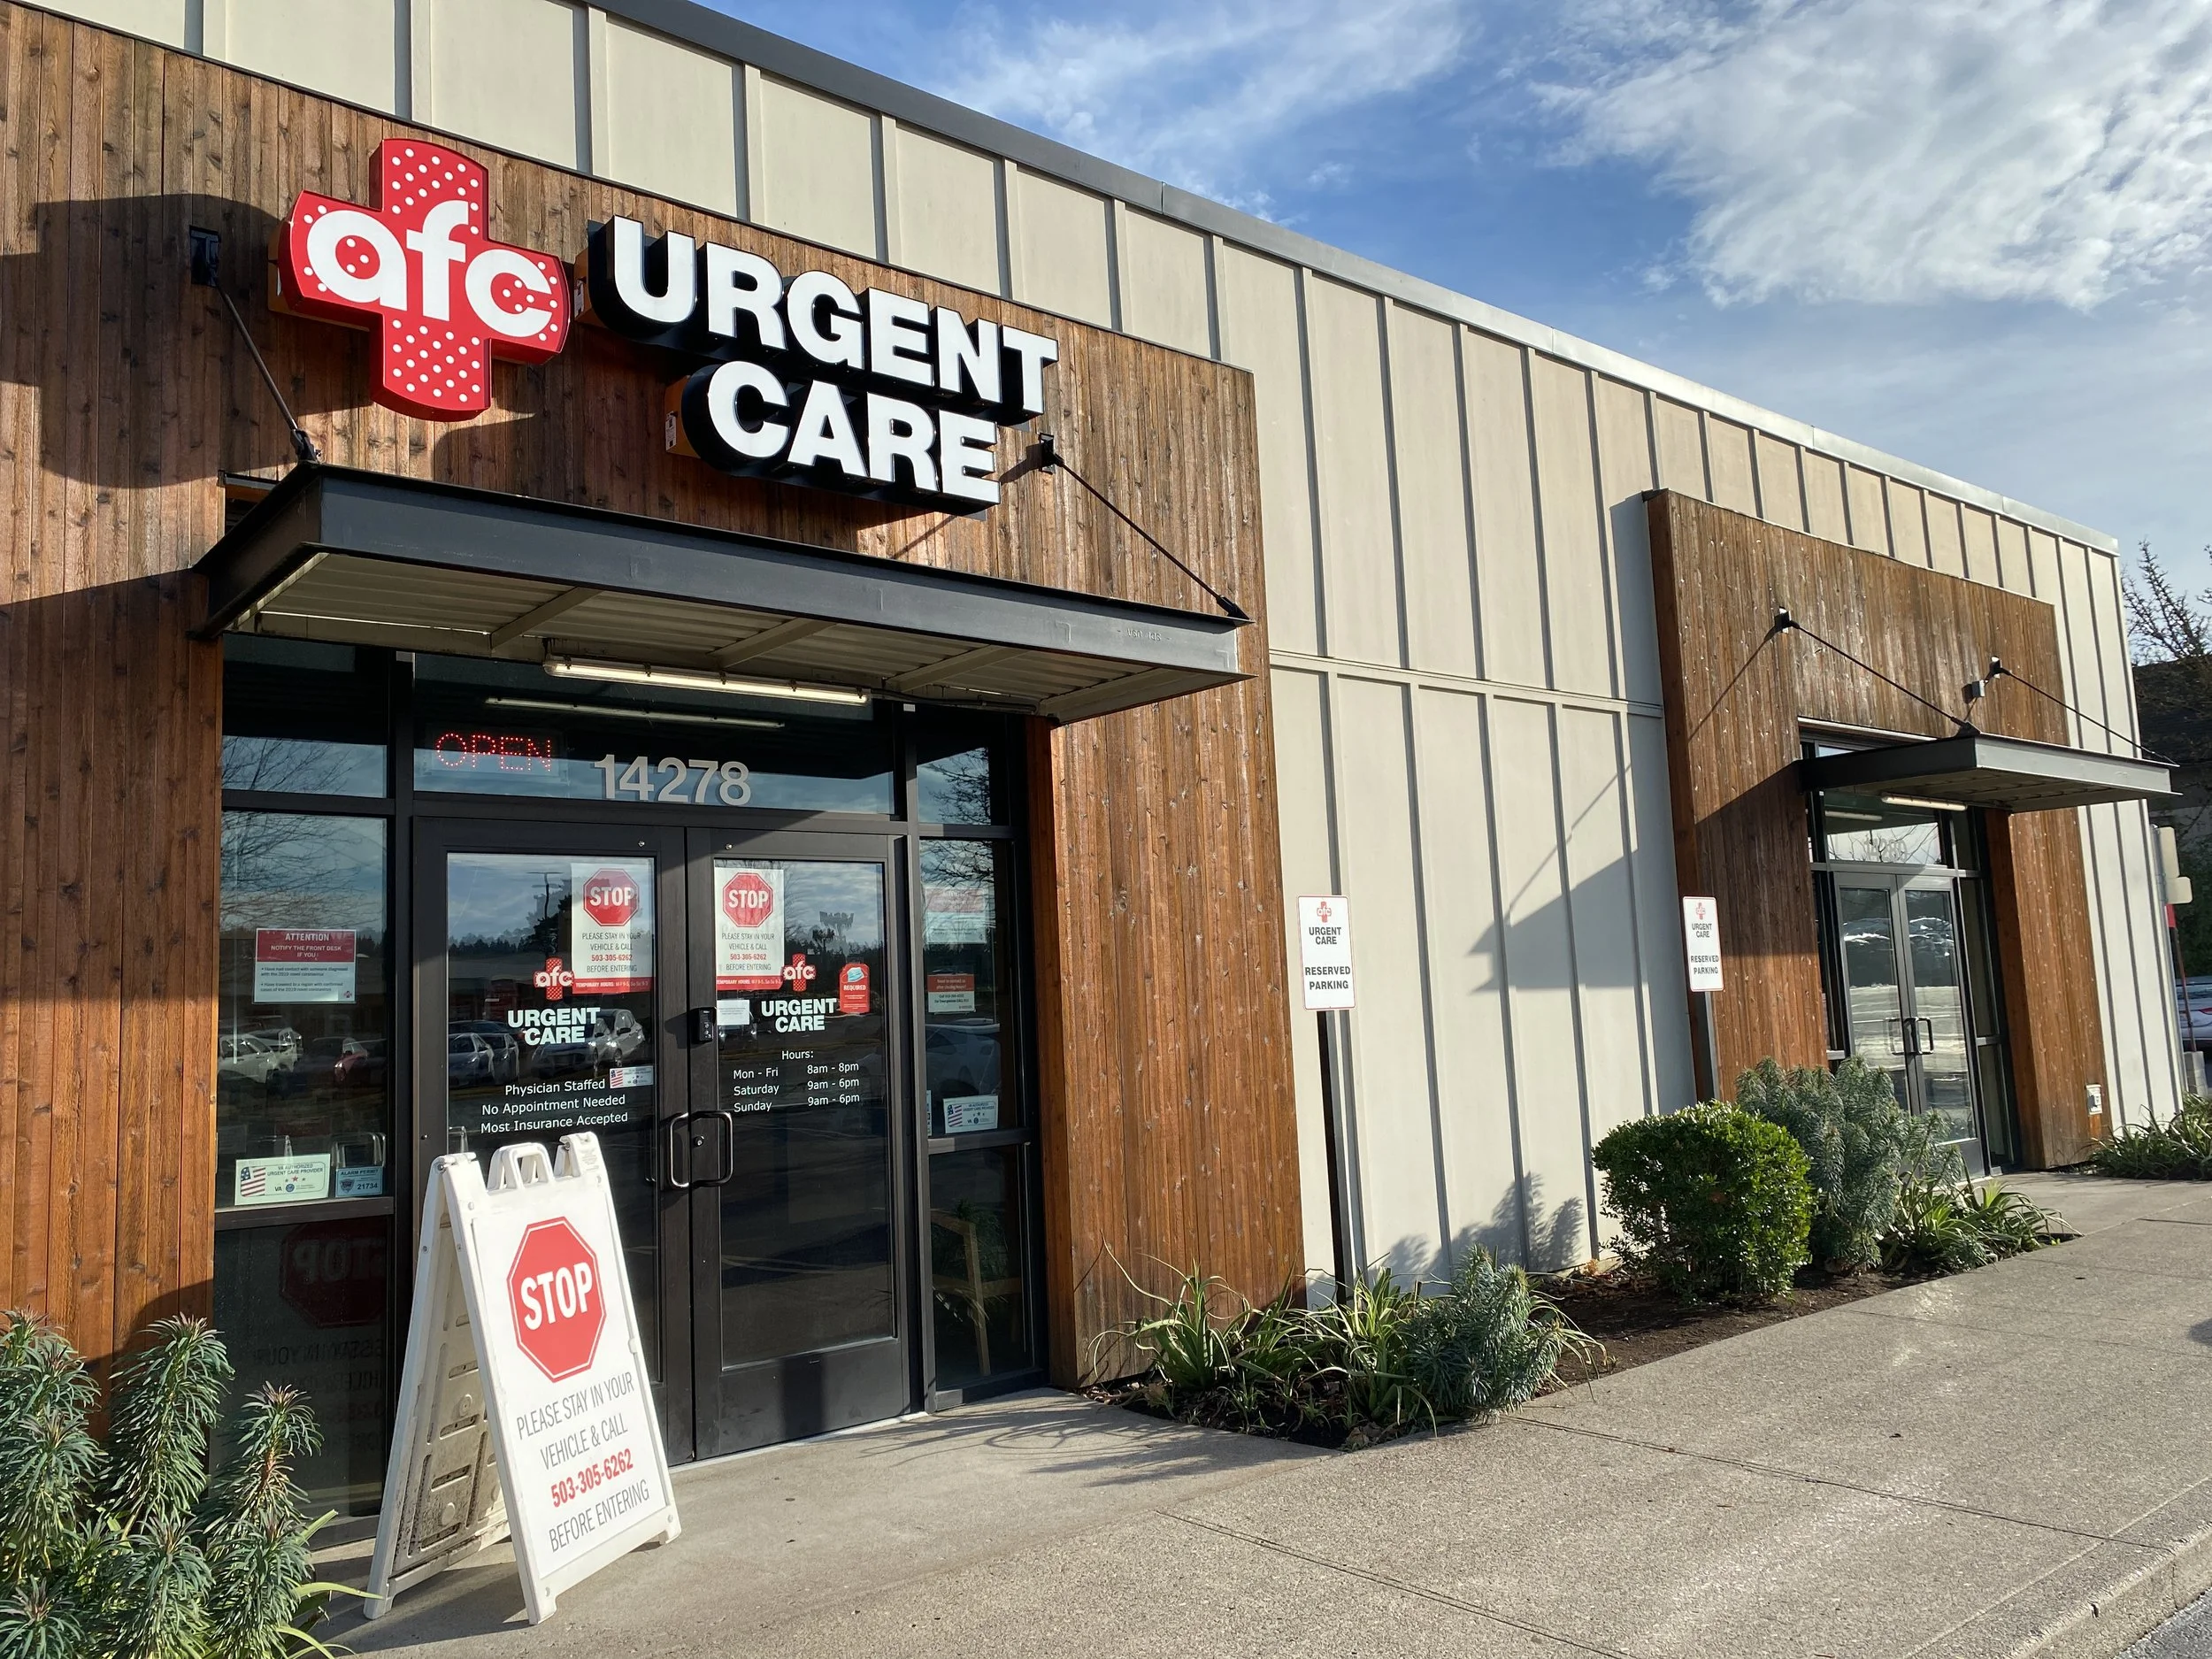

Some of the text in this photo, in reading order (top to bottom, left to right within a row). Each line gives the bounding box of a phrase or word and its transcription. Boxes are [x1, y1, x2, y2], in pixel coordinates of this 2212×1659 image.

[306, 199, 555, 336] afc
[613, 215, 1058, 415] URGENT
[708, 361, 1000, 504] CARE
[436, 733, 551, 772] OPEN
[594, 754, 751, 806] 14278
[590, 887, 634, 906] STOP
[728, 889, 769, 909] STOP
[1317, 905, 1332, 917] afc
[285, 933, 329, 941] ATTENTION
[1316, 936, 1337, 945] CARE
[535, 966, 573, 987] afc
[783, 960, 816, 980] afc
[1305, 966, 1350, 975] RESERVED
[1310, 980, 1348, 990] PARKING
[761, 998, 837, 1017] URGENT
[507, 1008, 601, 1028] URGENT
[775, 1015, 825, 1033] CARE
[524, 1026, 585, 1046] CARE
[781, 1050, 814, 1060] Hours:
[733, 1070, 755, 1079] Mon
[765, 1067, 779, 1078] Fri
[807, 1064, 828, 1074] 8am
[838, 1063, 859, 1073] 8pm
[505, 1079, 605, 1097] Physician Staffed
[733, 1083, 780, 1096] Saturday
[807, 1080, 828, 1090] 9am
[839, 1078, 859, 1089] 6pm
[481, 1094, 626, 1116] No Appointment Needed
[733, 1101, 772, 1112] Sunday
[807, 1096, 829, 1106] 9am
[839, 1094, 860, 1105] 6pm
[480, 1112, 628, 1133] Most Insurance Accepted
[520, 1263, 593, 1331] STOP
[517, 1371, 634, 1440] PLEASE STAY IN YOUR
[541, 1413, 628, 1470] VEHICLE & CALL
[551, 1448, 633, 1508] 503-305-6262
[549, 1479, 649, 1553] BEFORE ENTERING
